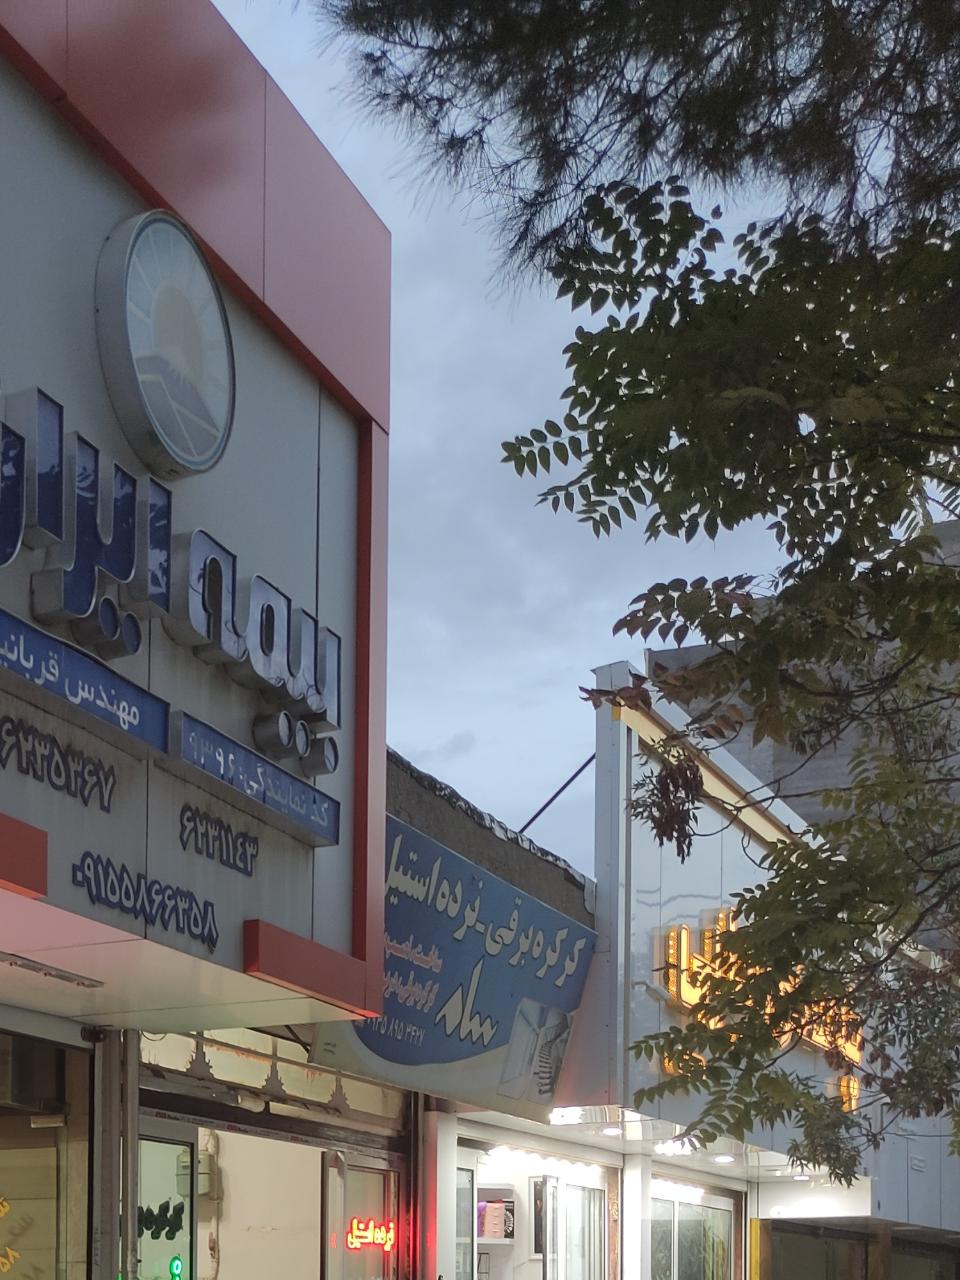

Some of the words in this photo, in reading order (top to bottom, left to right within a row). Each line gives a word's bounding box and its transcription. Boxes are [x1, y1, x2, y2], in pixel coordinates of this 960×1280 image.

[187, 528, 342, 774] بیمه
[64, 677, 140, 731] مهندس
[436, 878, 484, 941] نرده
[484, 896, 535, 967] برقی
[532, 926, 588, 988] کرکره
